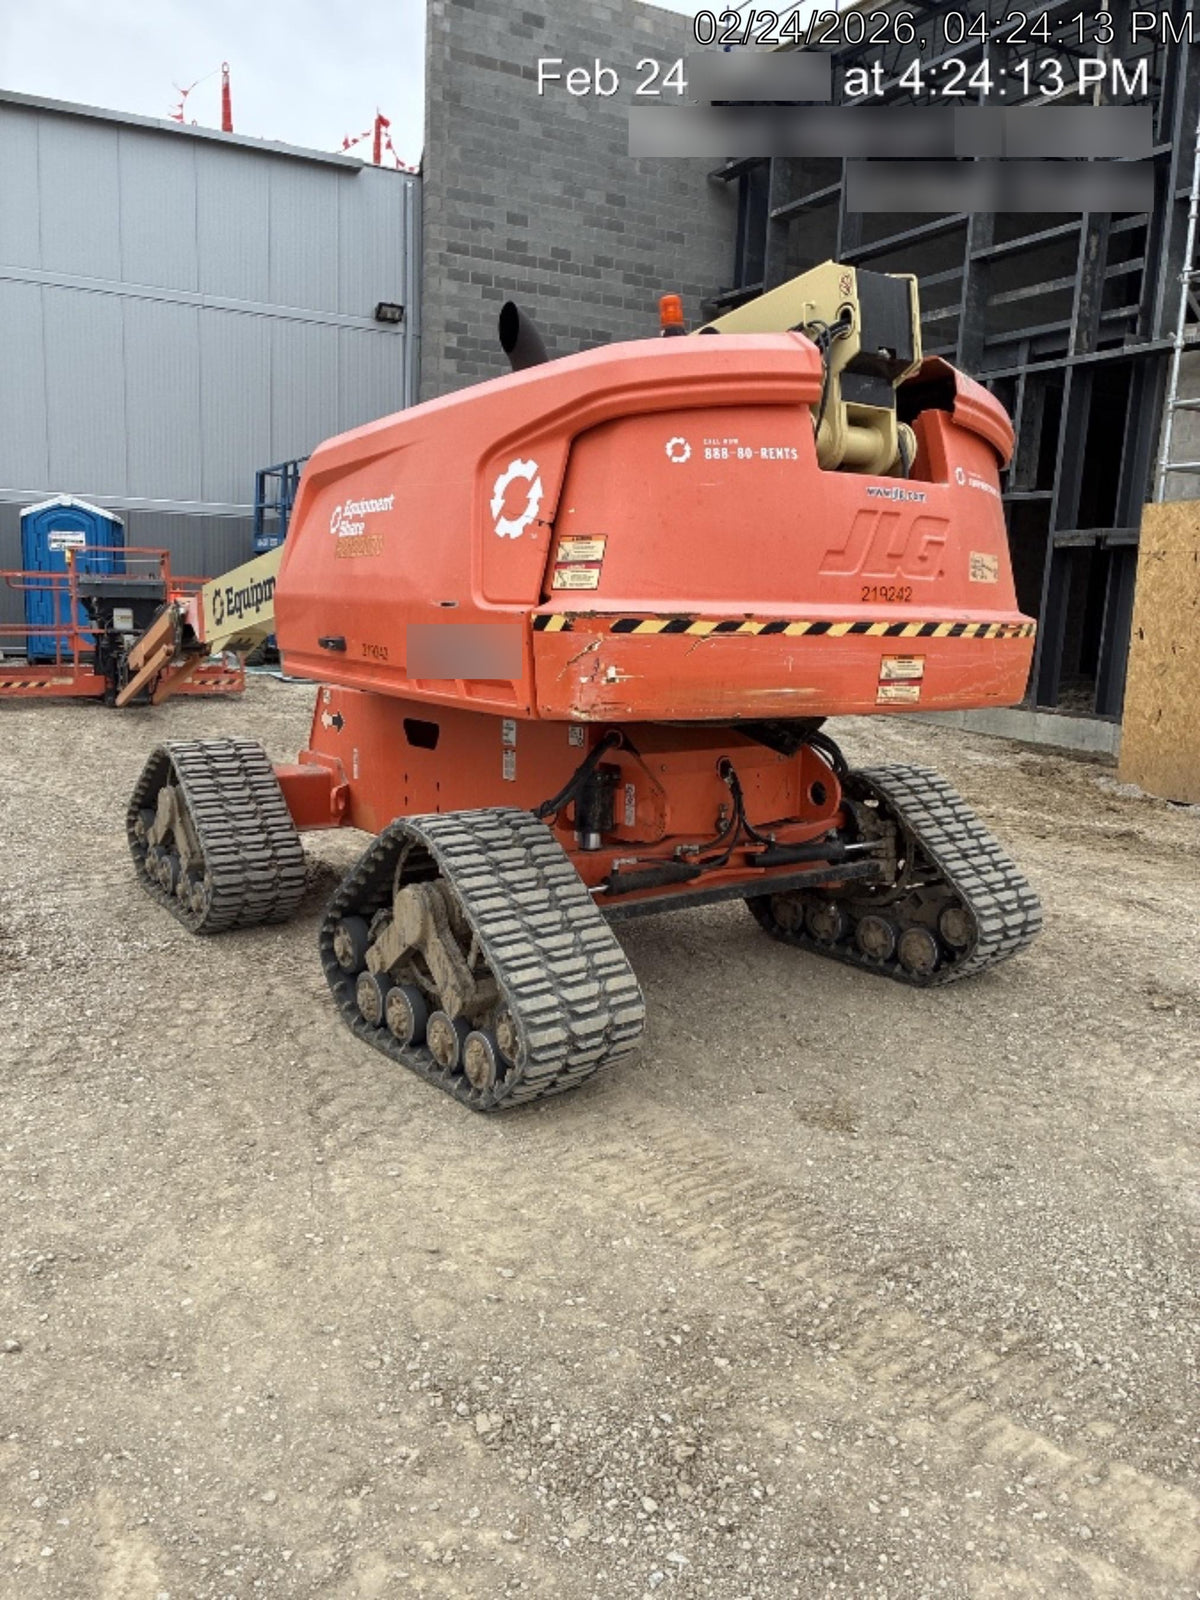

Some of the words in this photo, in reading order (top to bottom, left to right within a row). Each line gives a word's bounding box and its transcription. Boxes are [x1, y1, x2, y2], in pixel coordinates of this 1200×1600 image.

[704, 447, 798, 460] 888-80-RENTS
[818, 508, 950, 581] JLG
[861, 585, 912, 603] 219242
